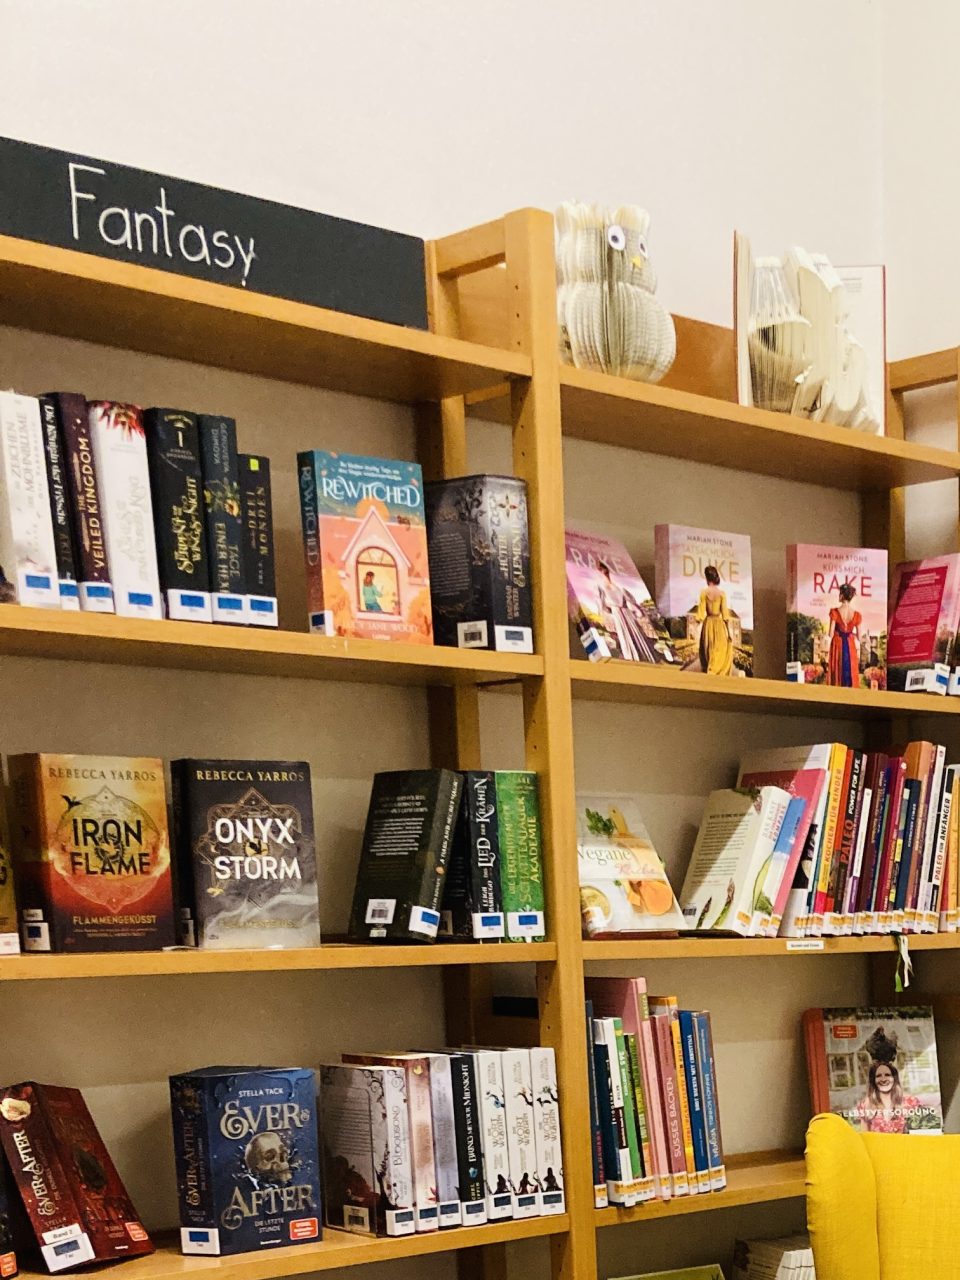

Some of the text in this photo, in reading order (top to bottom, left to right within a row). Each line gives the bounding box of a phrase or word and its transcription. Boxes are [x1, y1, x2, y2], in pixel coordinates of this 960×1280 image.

[69, 162, 256, 287] Fantasy
[78, 494, 86, 511] THE
[79, 437, 104, 569] VEILED KINGDOM
[321, 475, 420, 508] REWITCHED
[215, 522, 227, 560] EINER
[713, 537, 732, 546] STONE
[229, 544, 241, 578] TAGE
[682, 555, 740, 584] DUKE
[846, 554, 867, 562] STONE
[814, 572, 872, 597] RAKE
[49, 767, 157, 782] REBECCA YARROS
[196, 770, 304, 782] REBECCA YARROS
[473, 777, 497, 868] LIED KRÄHEN
[824, 768, 843, 865] KOCHEN FÜR KINDER
[839, 757, 863, 865] PALEO POWER FOR LIFE
[72, 818, 143, 847] IRON
[214, 818, 295, 844] ONYX
[933, 797, 951, 881] PALEO ANFÄNGER
[71, 851, 151, 876] FLAME
[528, 814, 541, 883] AKADEMIE
[577, 845, 632, 869] Vegane
[214, 855, 302, 880] STORM
[73, 914, 157, 925] FLAMMENGEKÜSST
[618, 1050, 626, 1066] 365
[238, 1087, 284, 1098] STELLA TACK
[460, 1064, 474, 1106] MIDNIGHT
[665, 1076, 678, 1117] BACKEN
[220, 1100, 300, 1140] EVER
[20, 1129, 44, 1176] AFTER
[220, 1184, 313, 1230] AFTER
